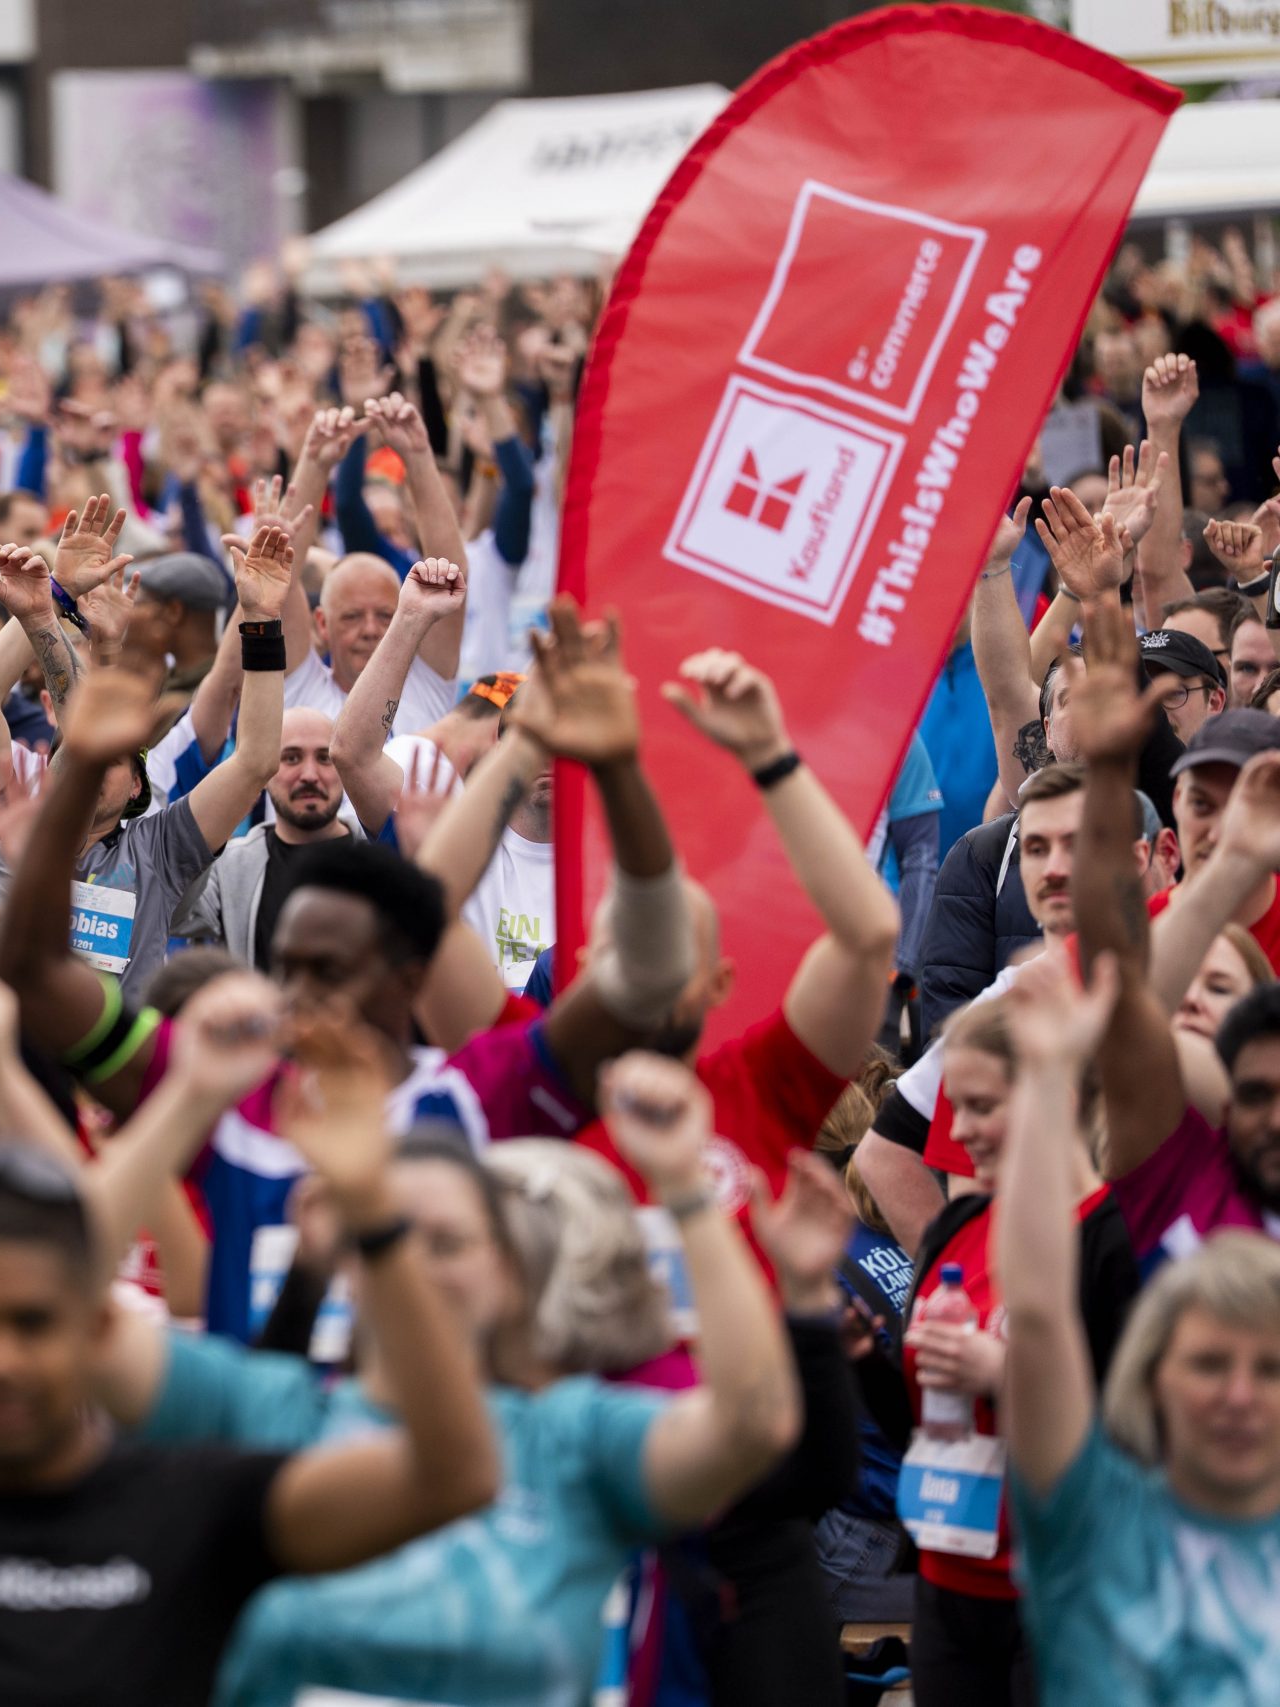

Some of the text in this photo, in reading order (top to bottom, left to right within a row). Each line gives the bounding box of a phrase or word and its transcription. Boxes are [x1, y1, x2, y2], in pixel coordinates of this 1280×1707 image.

[870, 238, 942, 390] commerce
[786, 441, 858, 582] Kaufland
[857, 243, 1043, 646] #ThisIsWhoWeAre
[72, 938, 95, 951] 1201
